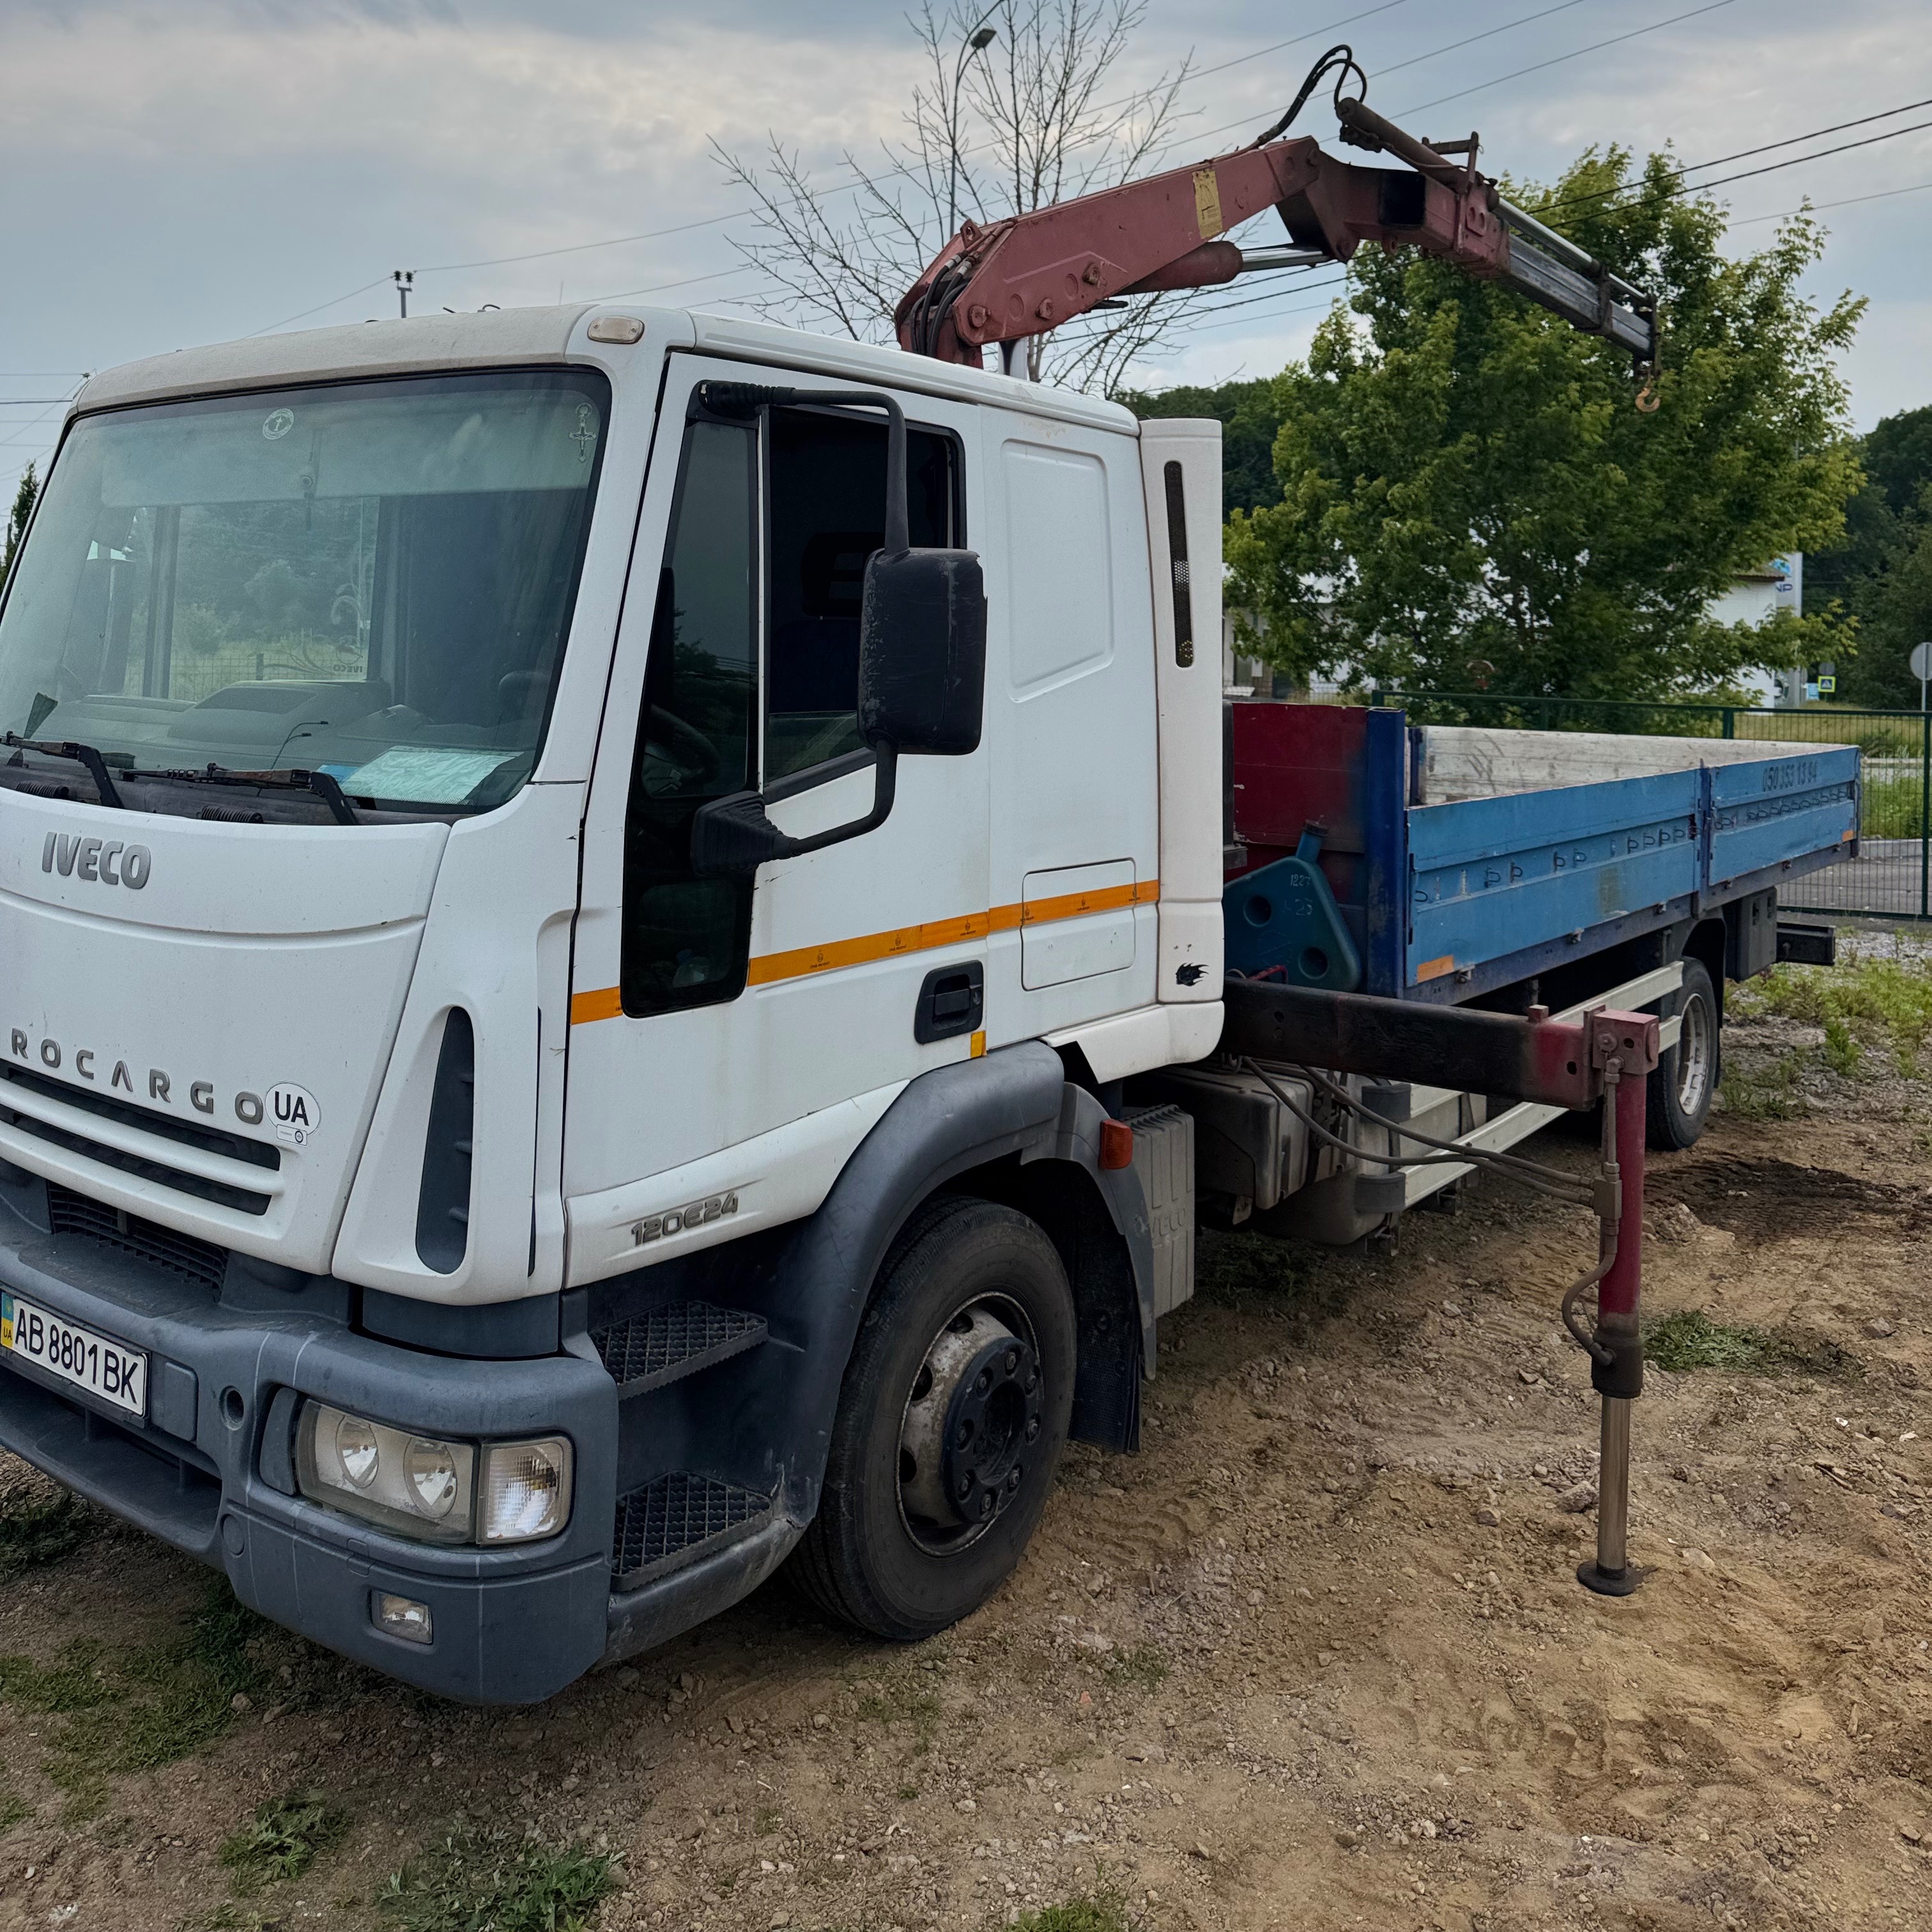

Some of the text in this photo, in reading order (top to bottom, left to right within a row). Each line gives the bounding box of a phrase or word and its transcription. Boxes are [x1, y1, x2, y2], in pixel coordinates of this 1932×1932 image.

[42, 831, 151, 889] IVECO
[11, 1027, 264, 1125] ROCARGO
[275, 1091, 309, 1126] UA
[631, 1192, 739, 1246] 120E24
[3, 1327, 13, 1341] UA
[15, 1308, 139, 1404] AB 8801 BK
